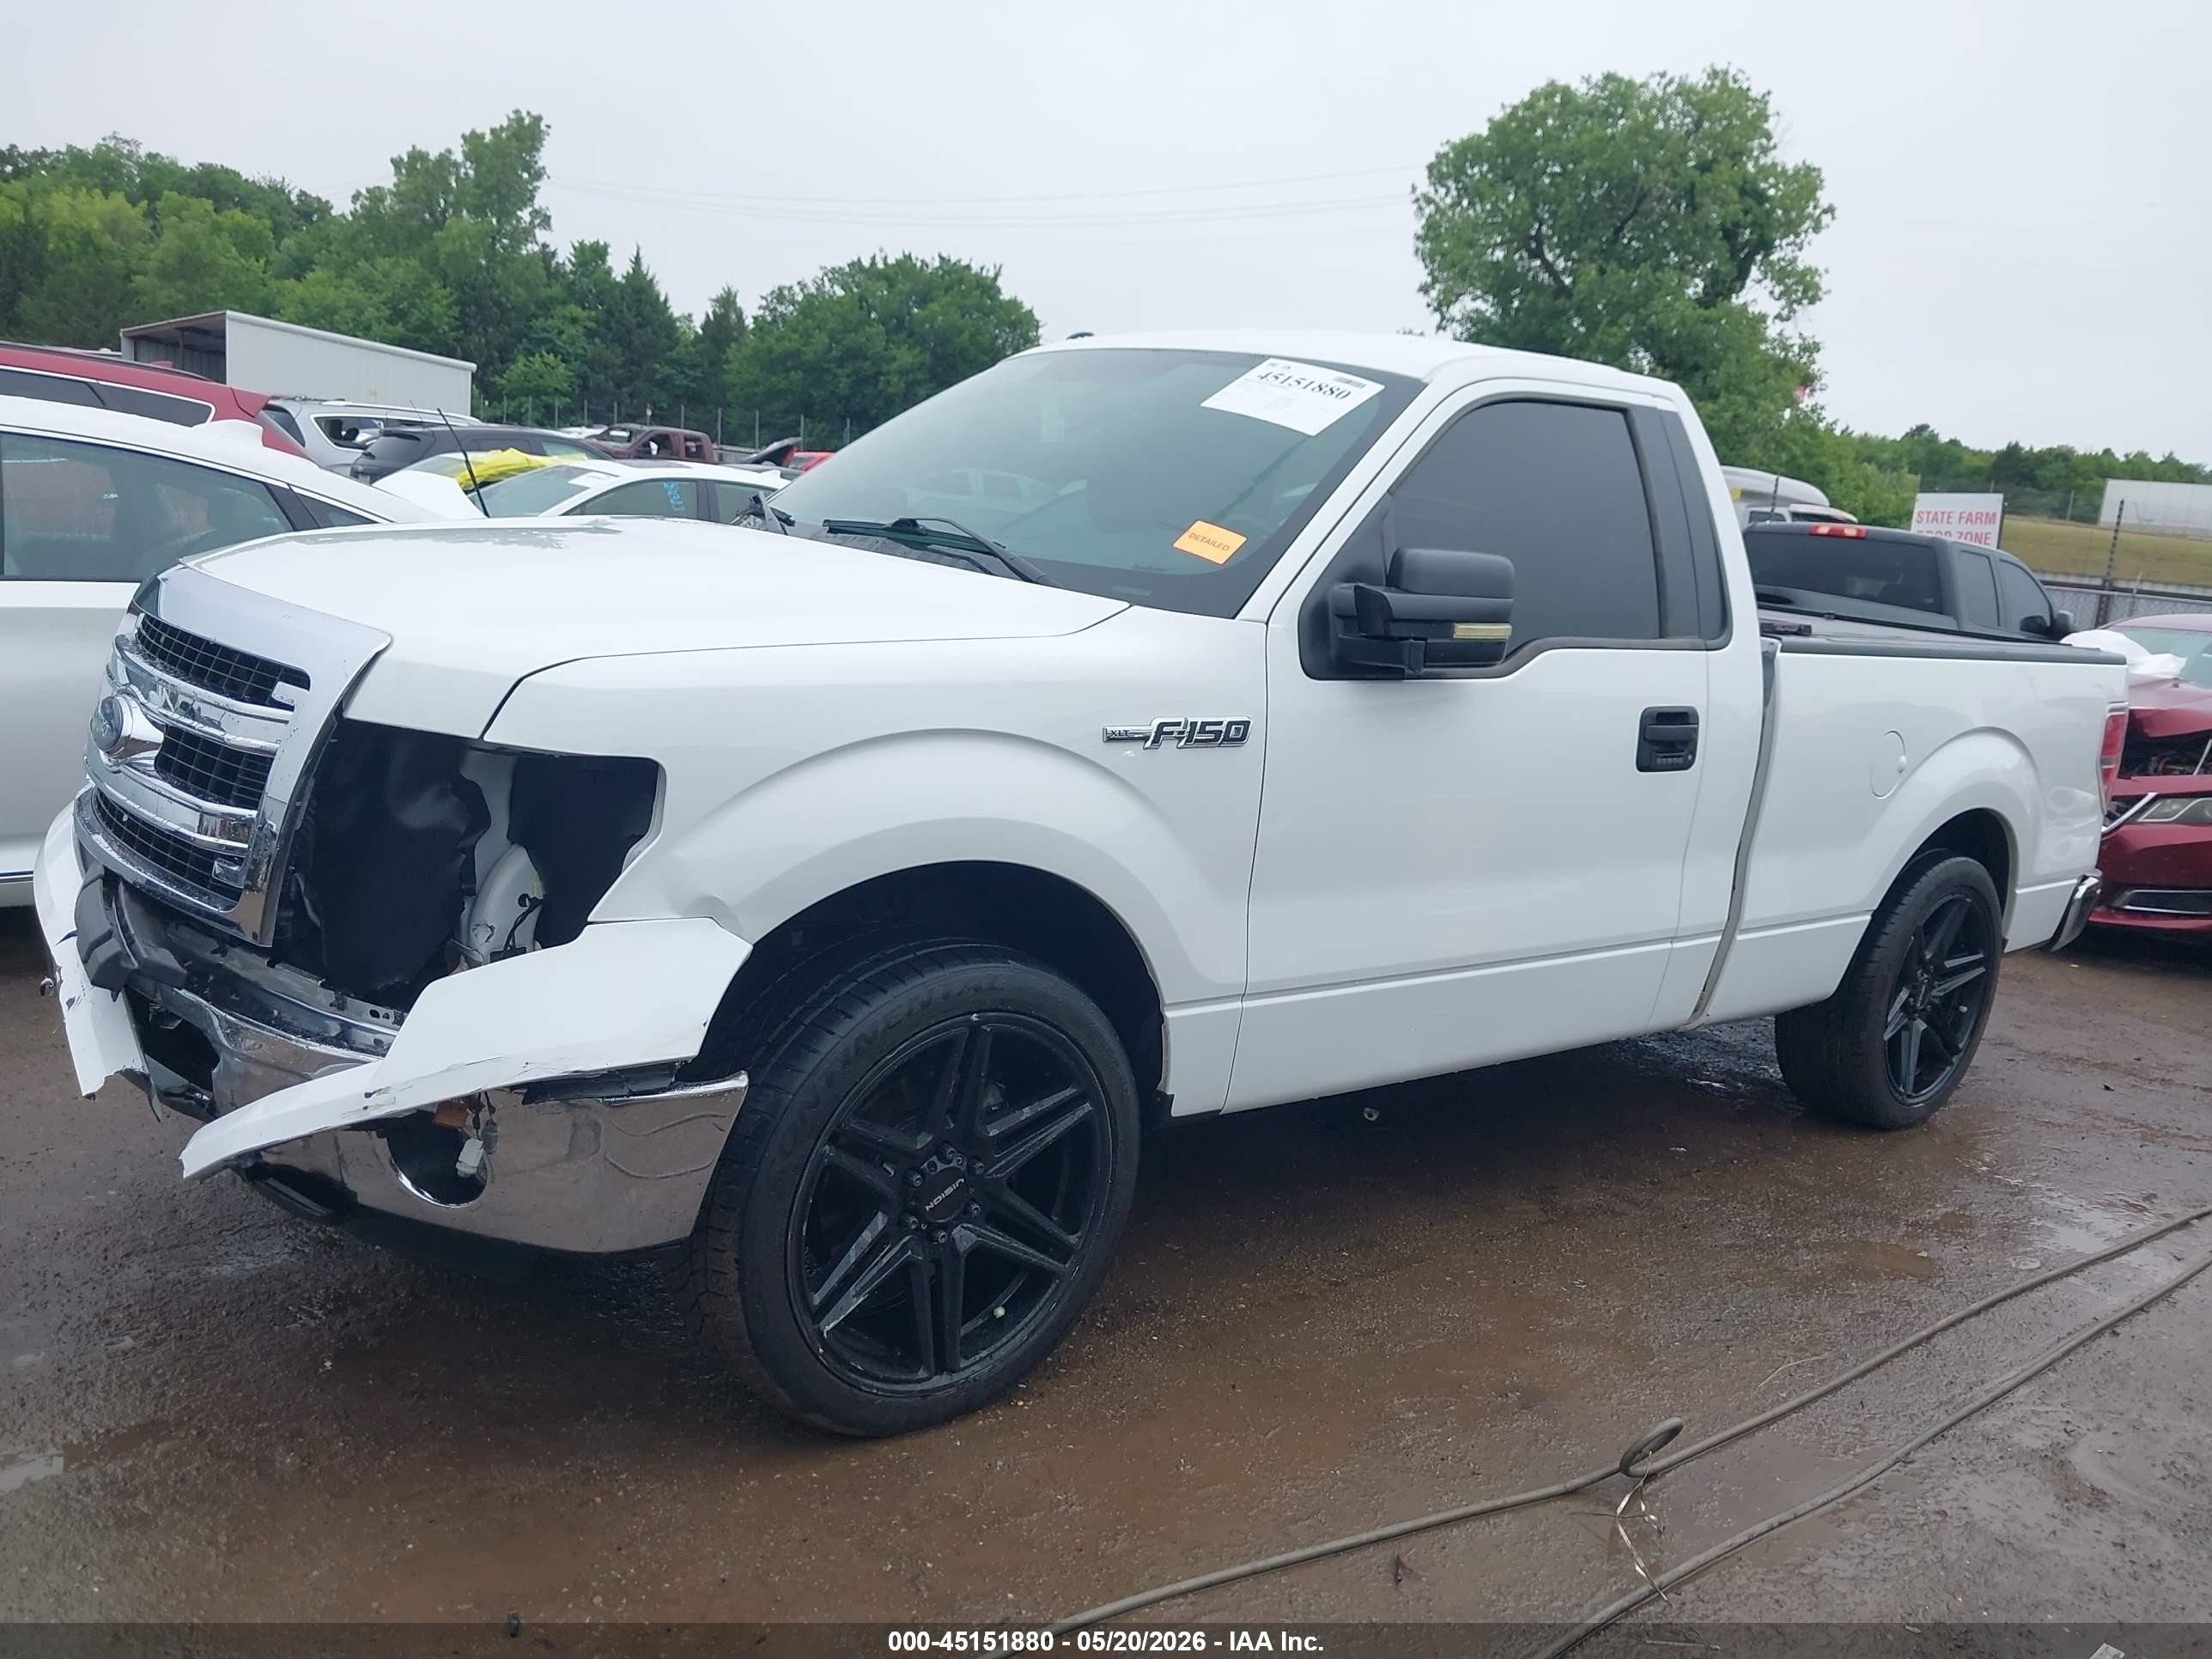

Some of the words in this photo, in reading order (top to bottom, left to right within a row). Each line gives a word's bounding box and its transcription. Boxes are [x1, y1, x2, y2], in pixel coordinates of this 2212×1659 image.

[1257, 371, 1352, 400] 45151880
[1916, 510, 1954, 525] STATE
[1958, 511, 1996, 526] FARM
[1188, 532, 1231, 551] DETAILED
[1957, 531, 1992, 545] ZONE
[1109, 729, 1130, 738] XLT
[1146, 716, 1252, 749] F-150
[925, 1178, 965, 1212] VISION
